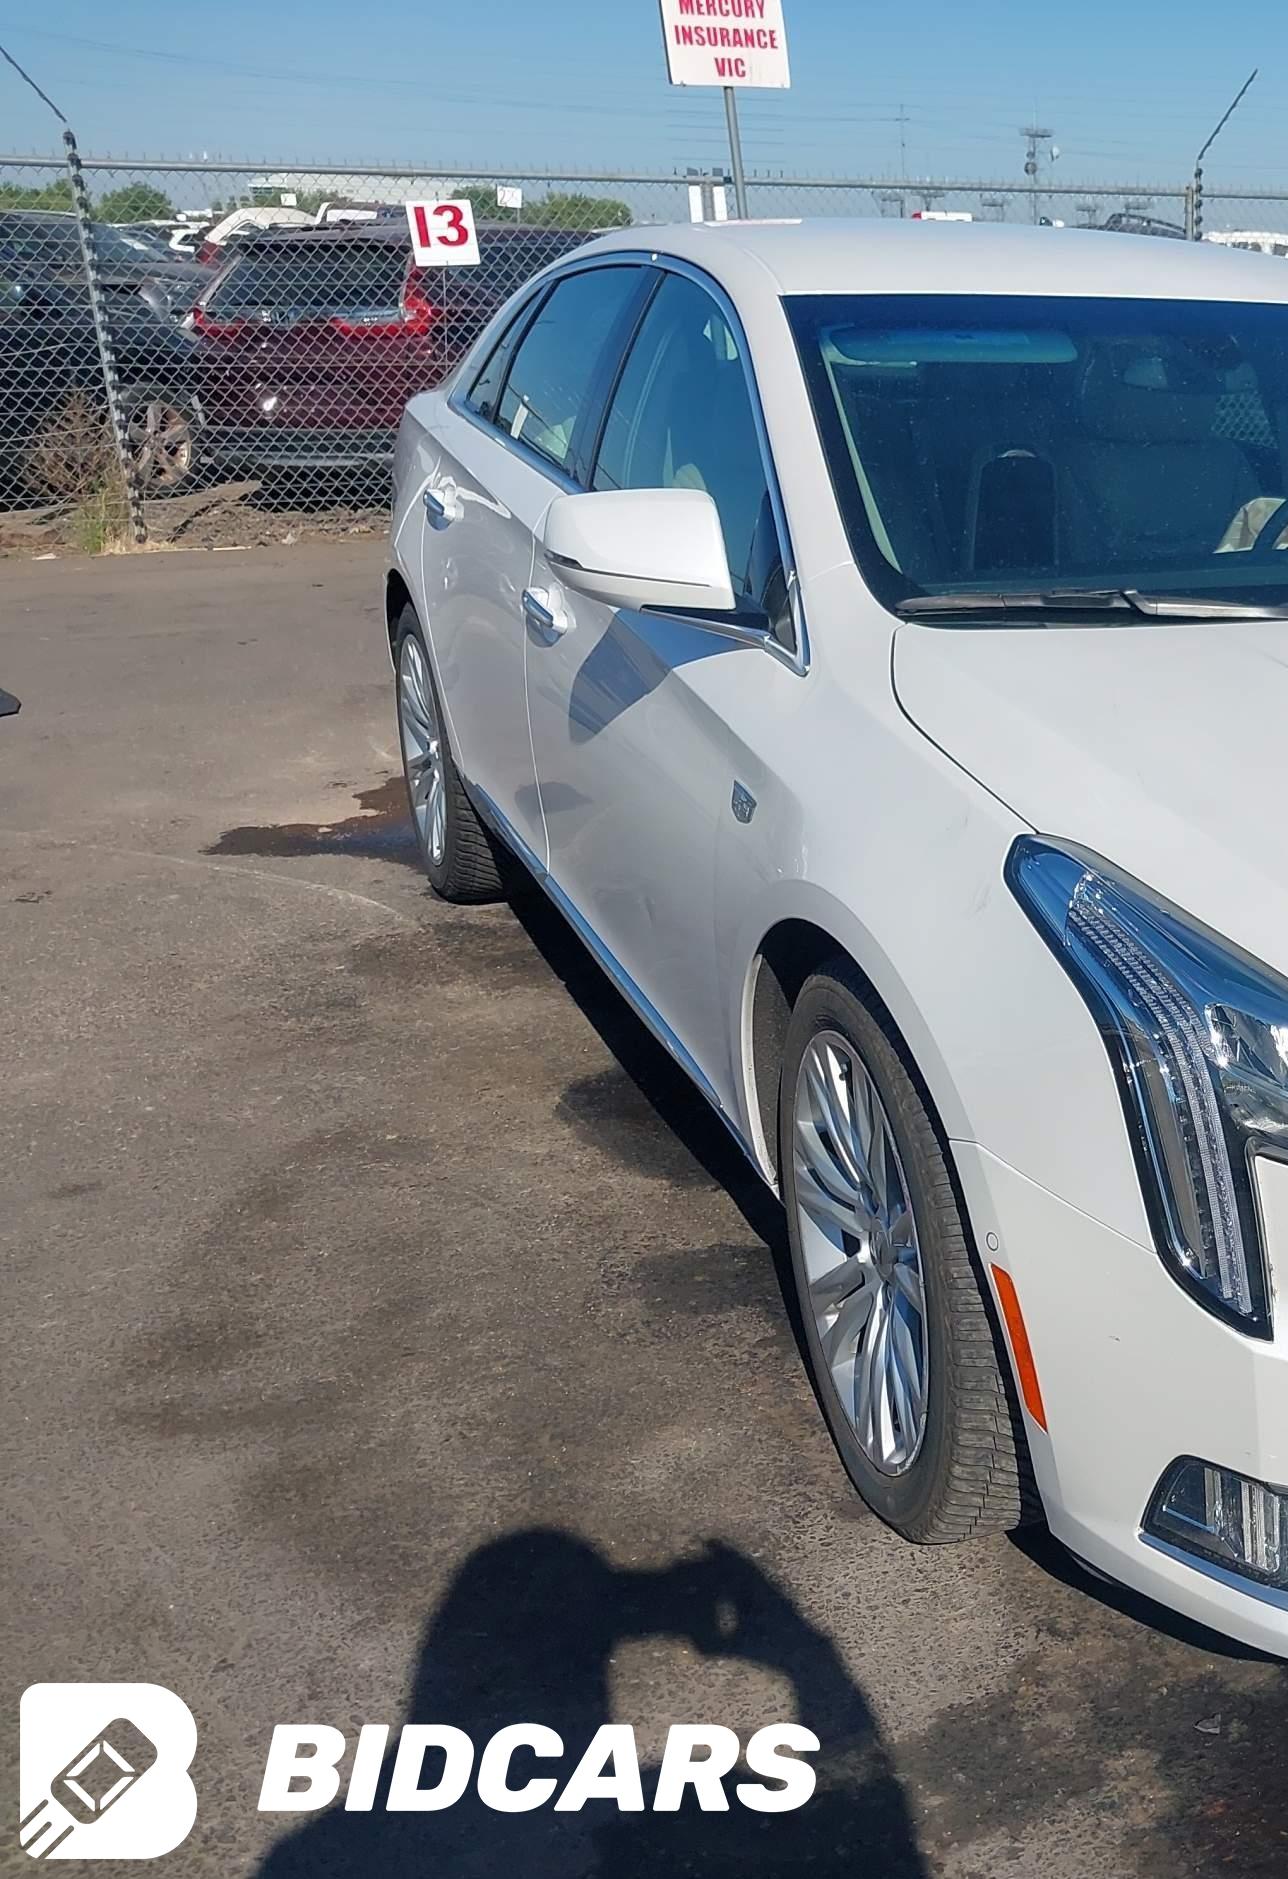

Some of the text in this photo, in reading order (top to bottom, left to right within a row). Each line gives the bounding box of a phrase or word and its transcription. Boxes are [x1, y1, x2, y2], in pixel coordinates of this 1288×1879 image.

[678, 0, 765, 18] MERCURY
[674, 25, 778, 49] INSURANCE
[714, 57, 746, 78] VIC
[413, 205, 469, 248] 13
